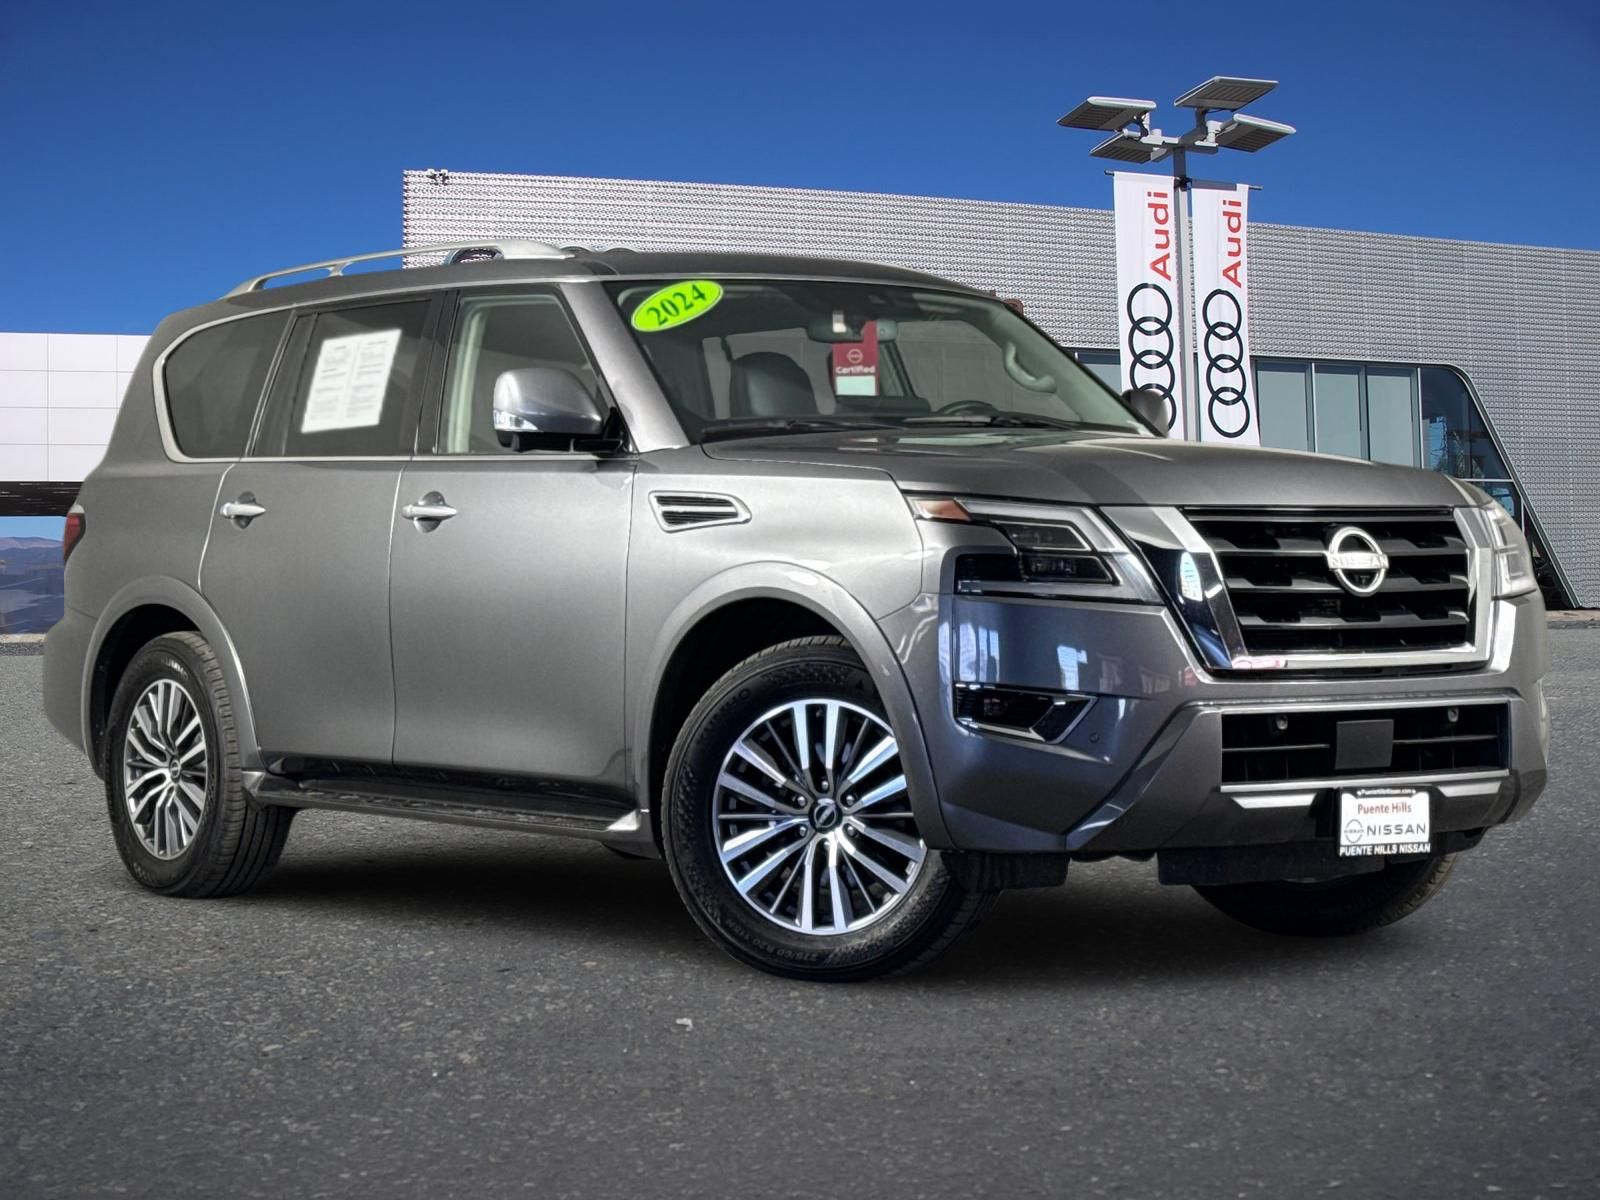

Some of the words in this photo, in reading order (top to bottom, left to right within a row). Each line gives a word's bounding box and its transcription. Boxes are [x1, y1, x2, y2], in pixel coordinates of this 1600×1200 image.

[1147, 191, 1172, 282] Audi
[1222, 199, 1243, 288] Audi
[646, 284, 707, 326] 2024
[1357, 803, 1390, 815] Puente
[1391, 801, 1412, 813] Hills
[1366, 824, 1426, 836] NISSAN
[1339, 845, 1373, 857] PUENTE
[1374, 844, 1397, 855] HILLS
[1399, 842, 1431, 854] NISSAN
